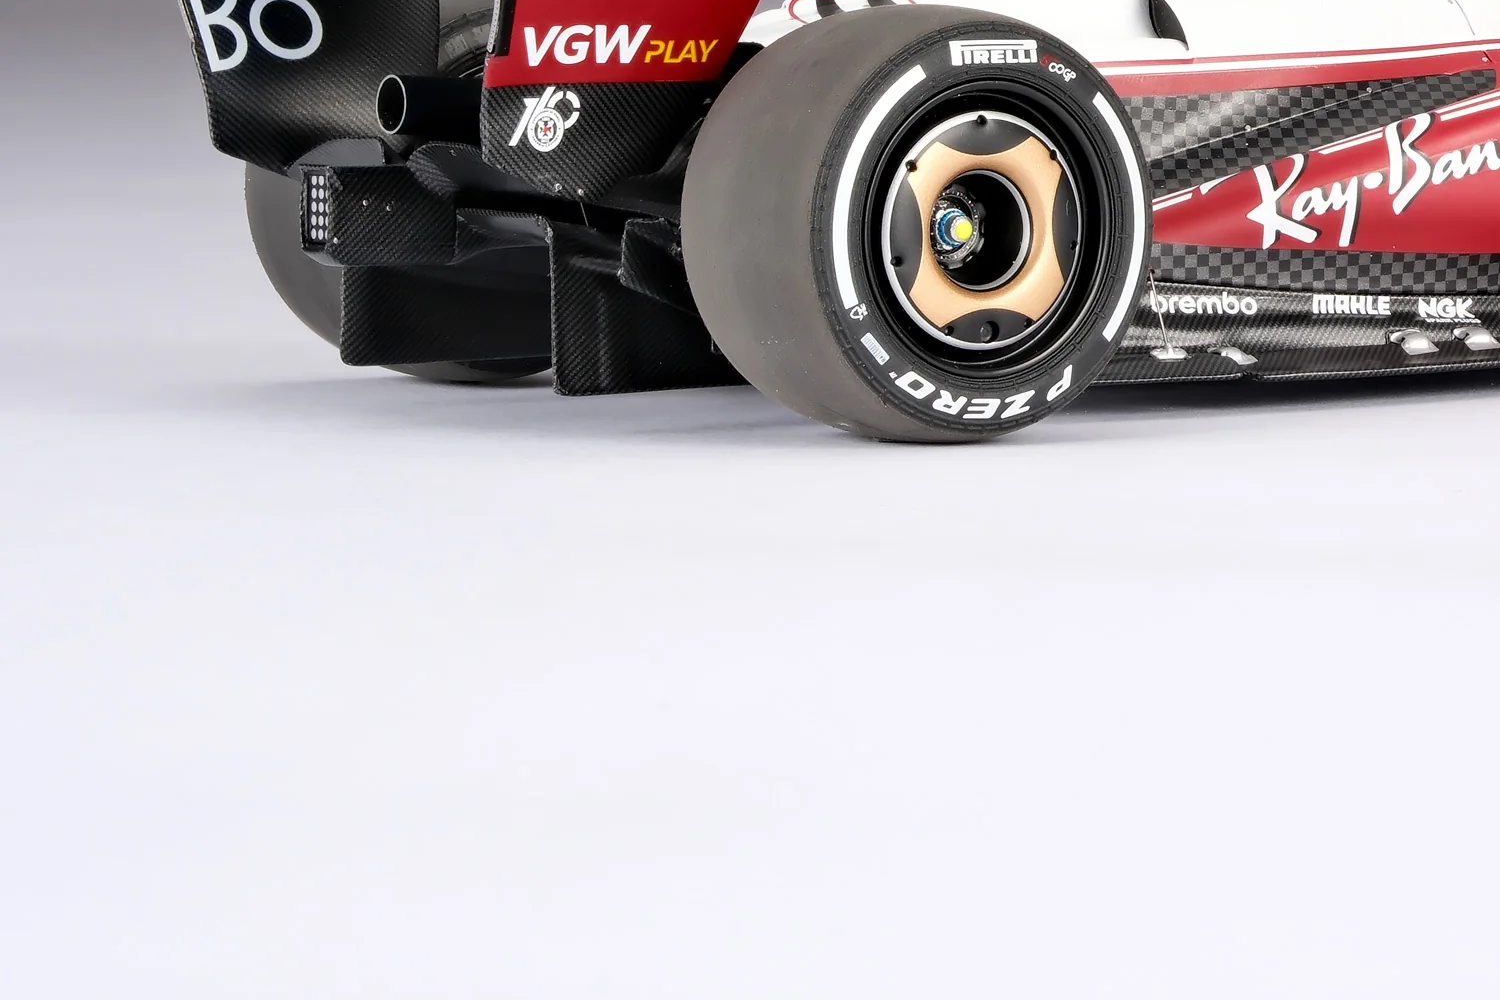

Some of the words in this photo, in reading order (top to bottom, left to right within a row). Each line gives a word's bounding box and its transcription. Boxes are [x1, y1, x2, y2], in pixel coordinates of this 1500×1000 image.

[949, 39, 1038, 67] PIRELLI
[1150, 291, 1258, 315] brembo
[1312, 294, 1392, 316] MAHLE
[1418, 297, 1474, 319] NGK
[894, 369, 1036, 419] ZERO
[1046, 364, 1073, 402] P
